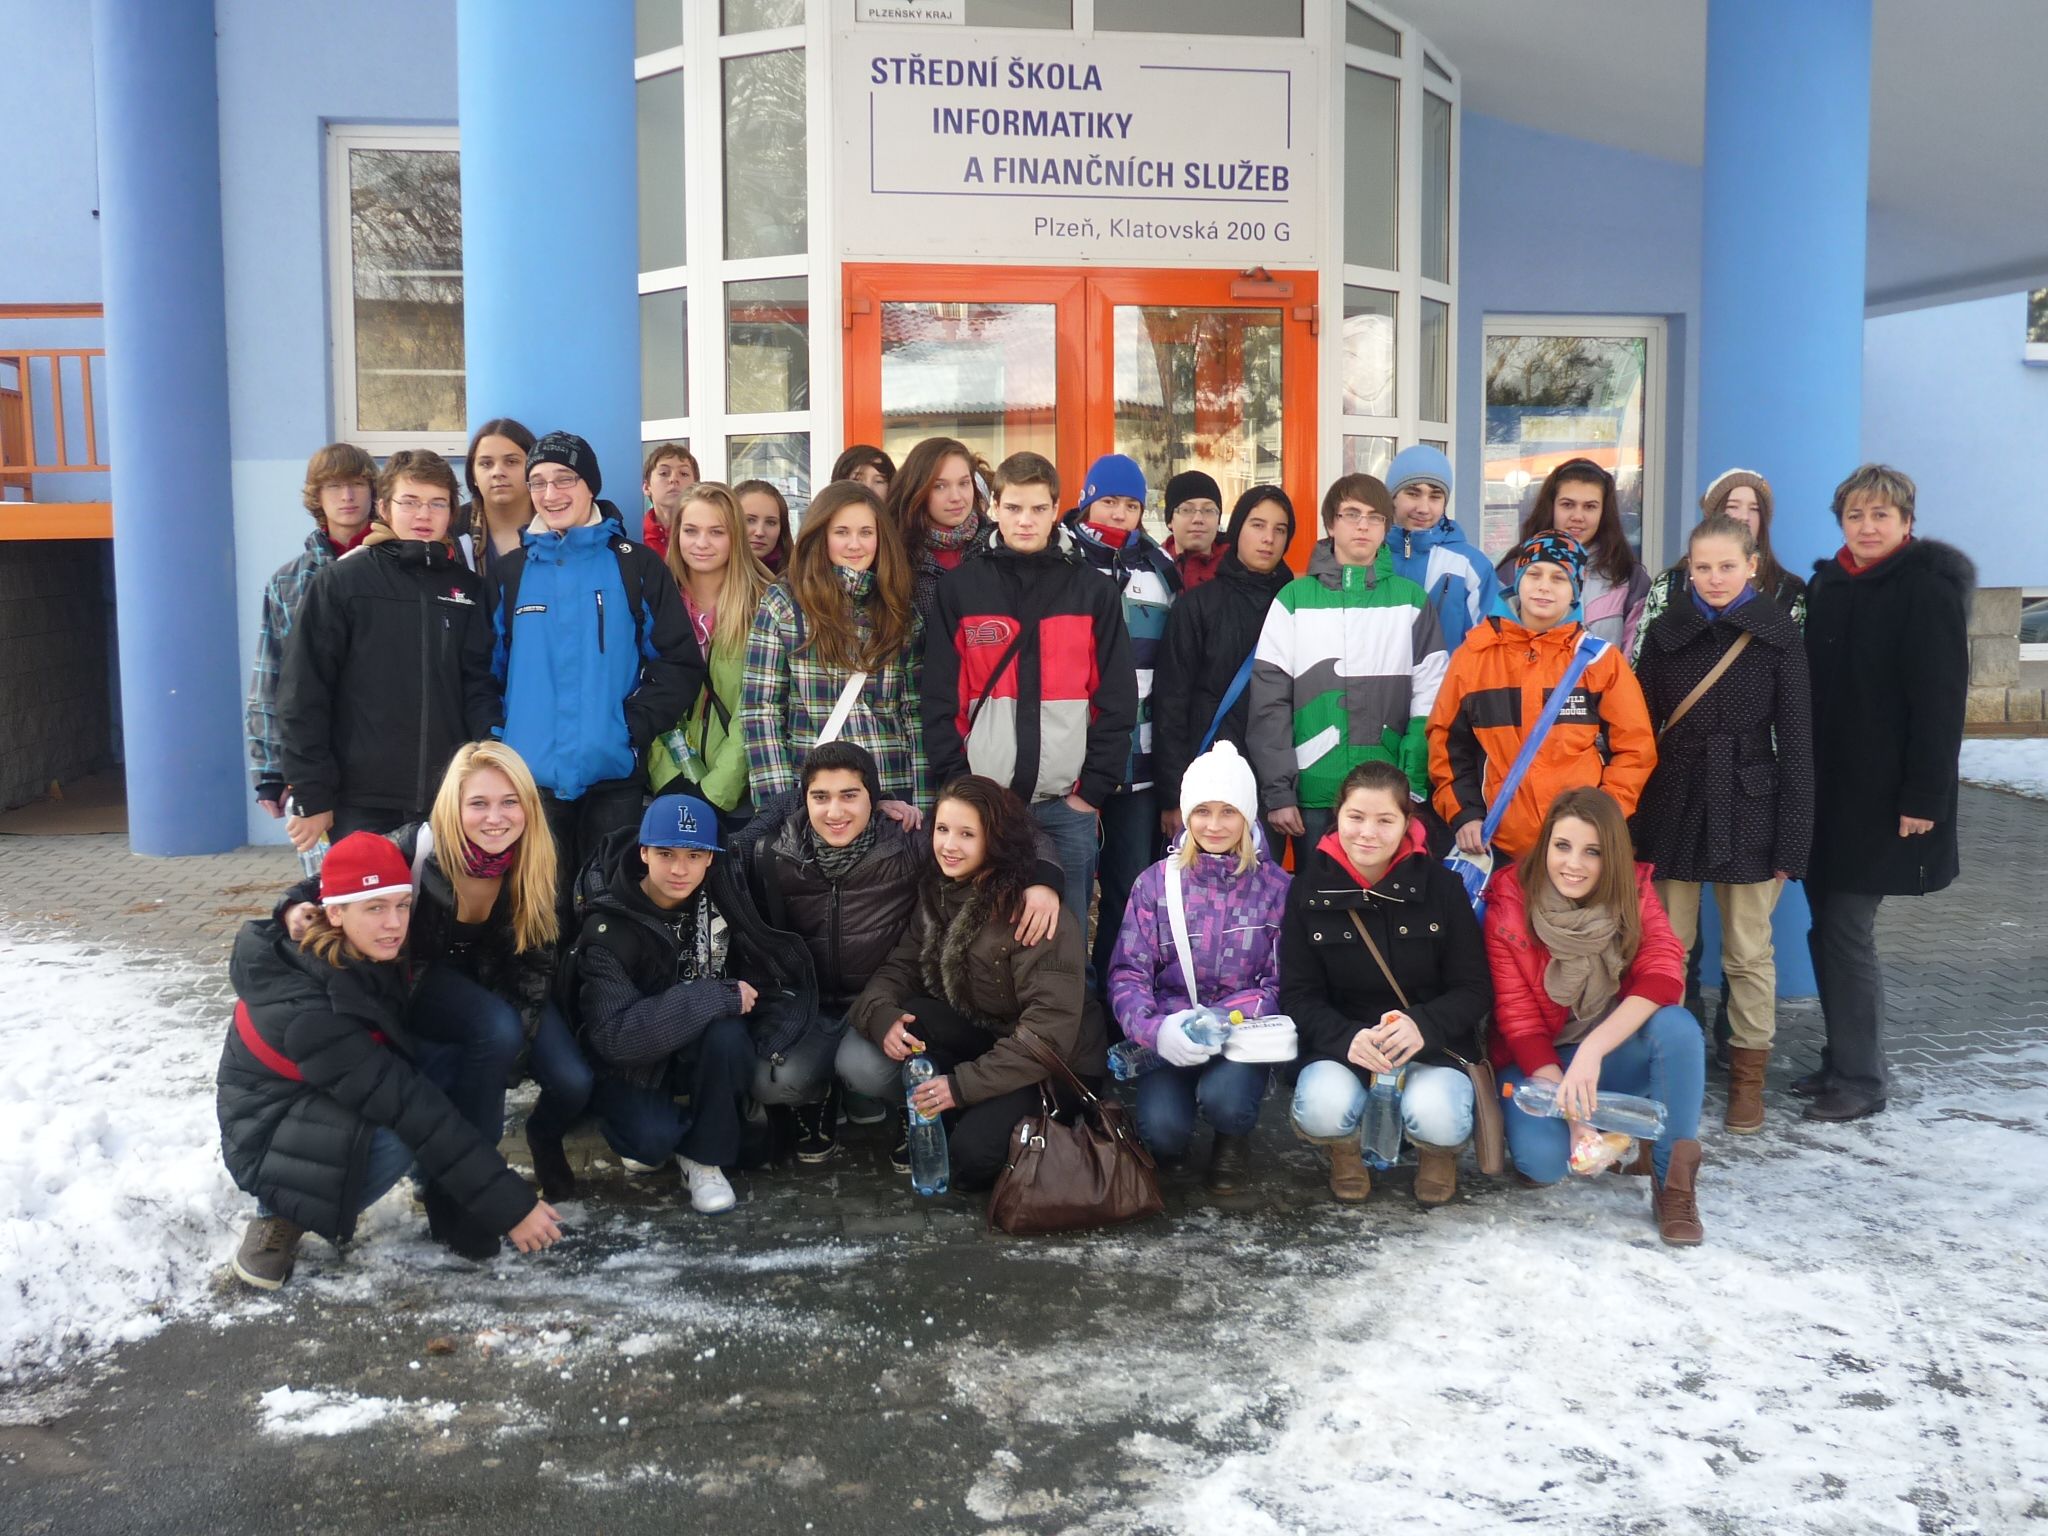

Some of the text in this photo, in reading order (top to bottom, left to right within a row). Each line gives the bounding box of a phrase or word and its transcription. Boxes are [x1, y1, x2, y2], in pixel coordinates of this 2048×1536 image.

[868, 8, 953, 19] PLZEŇSKÝ KRAJ
[871, 53, 1103, 91] STŘEDNÍ ŠKOLA
[933, 107, 1133, 139] INFORMATIKY
[963, 154, 1290, 191] A FINANČNÍCH SLUŽEB
[1034, 217, 1290, 242] Plzeň, Klatovská 200 G
[678, 805, 698, 833] LA
